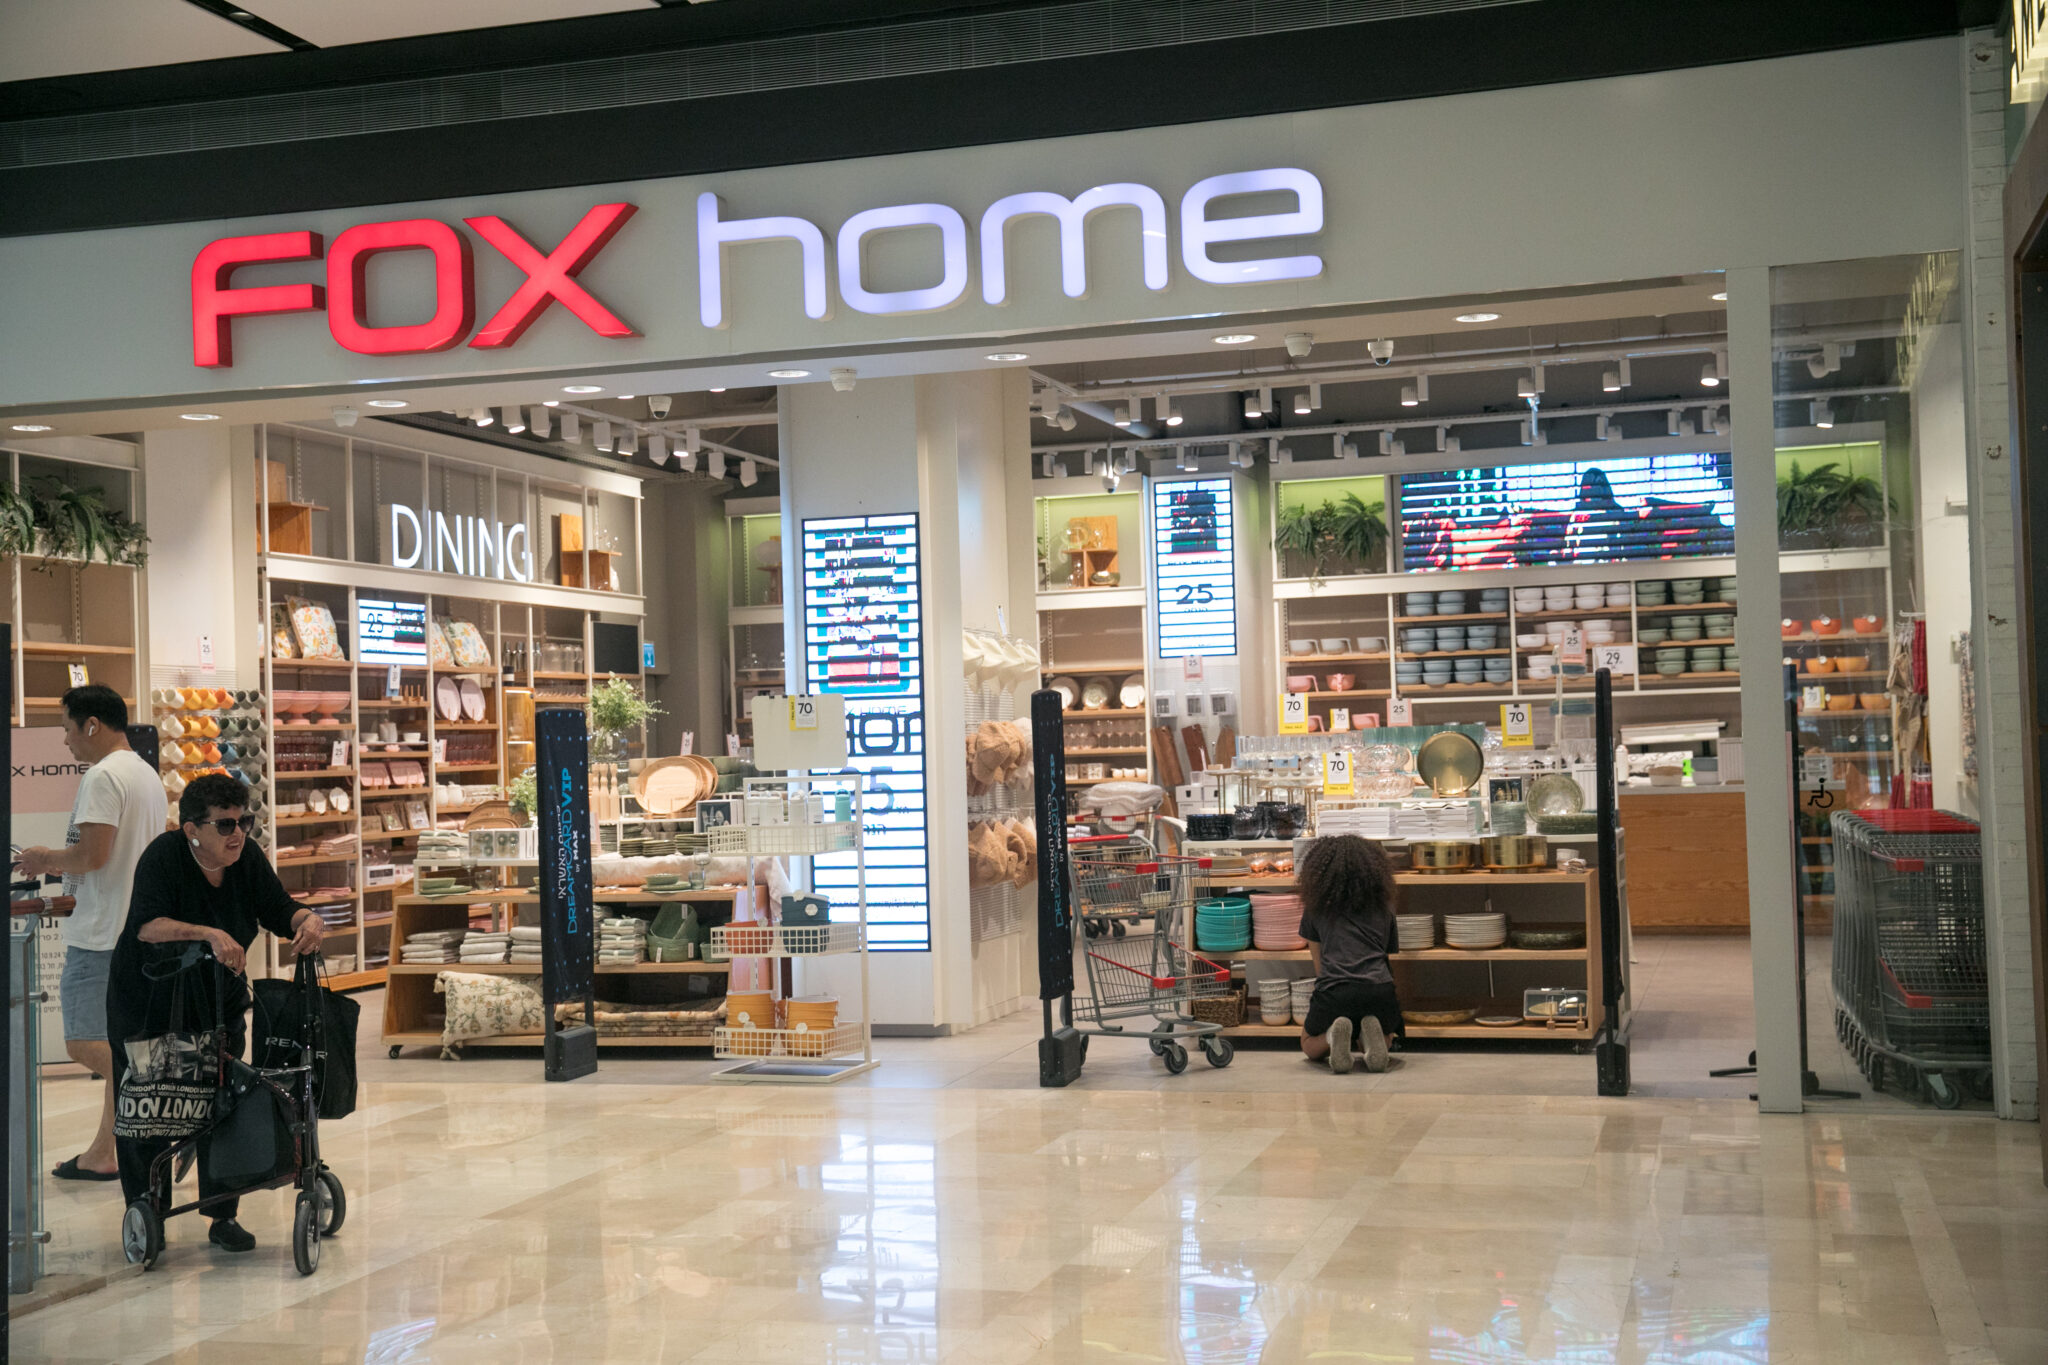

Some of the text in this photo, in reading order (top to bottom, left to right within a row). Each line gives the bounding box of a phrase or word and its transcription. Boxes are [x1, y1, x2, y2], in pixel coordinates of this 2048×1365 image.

[192, 168, 1324, 368] FOX home
[391, 503, 534, 583] DINING
[1175, 584, 1214, 605] 25
[367, 612, 384, 633] 25
[1566, 637, 1578, 645] 25
[1606, 652, 1620, 665] 29
[72, 671, 83, 682] 70
[798, 702, 813, 714] 70
[1286, 701, 1301, 711] 70
[1393, 705, 1405, 713] 25
[1509, 711, 1525, 723] 70
[31, 763, 89, 777] HOME
[1330, 760, 1345, 771] 70
[561, 767, 578, 934] DREAMCARD VIP
